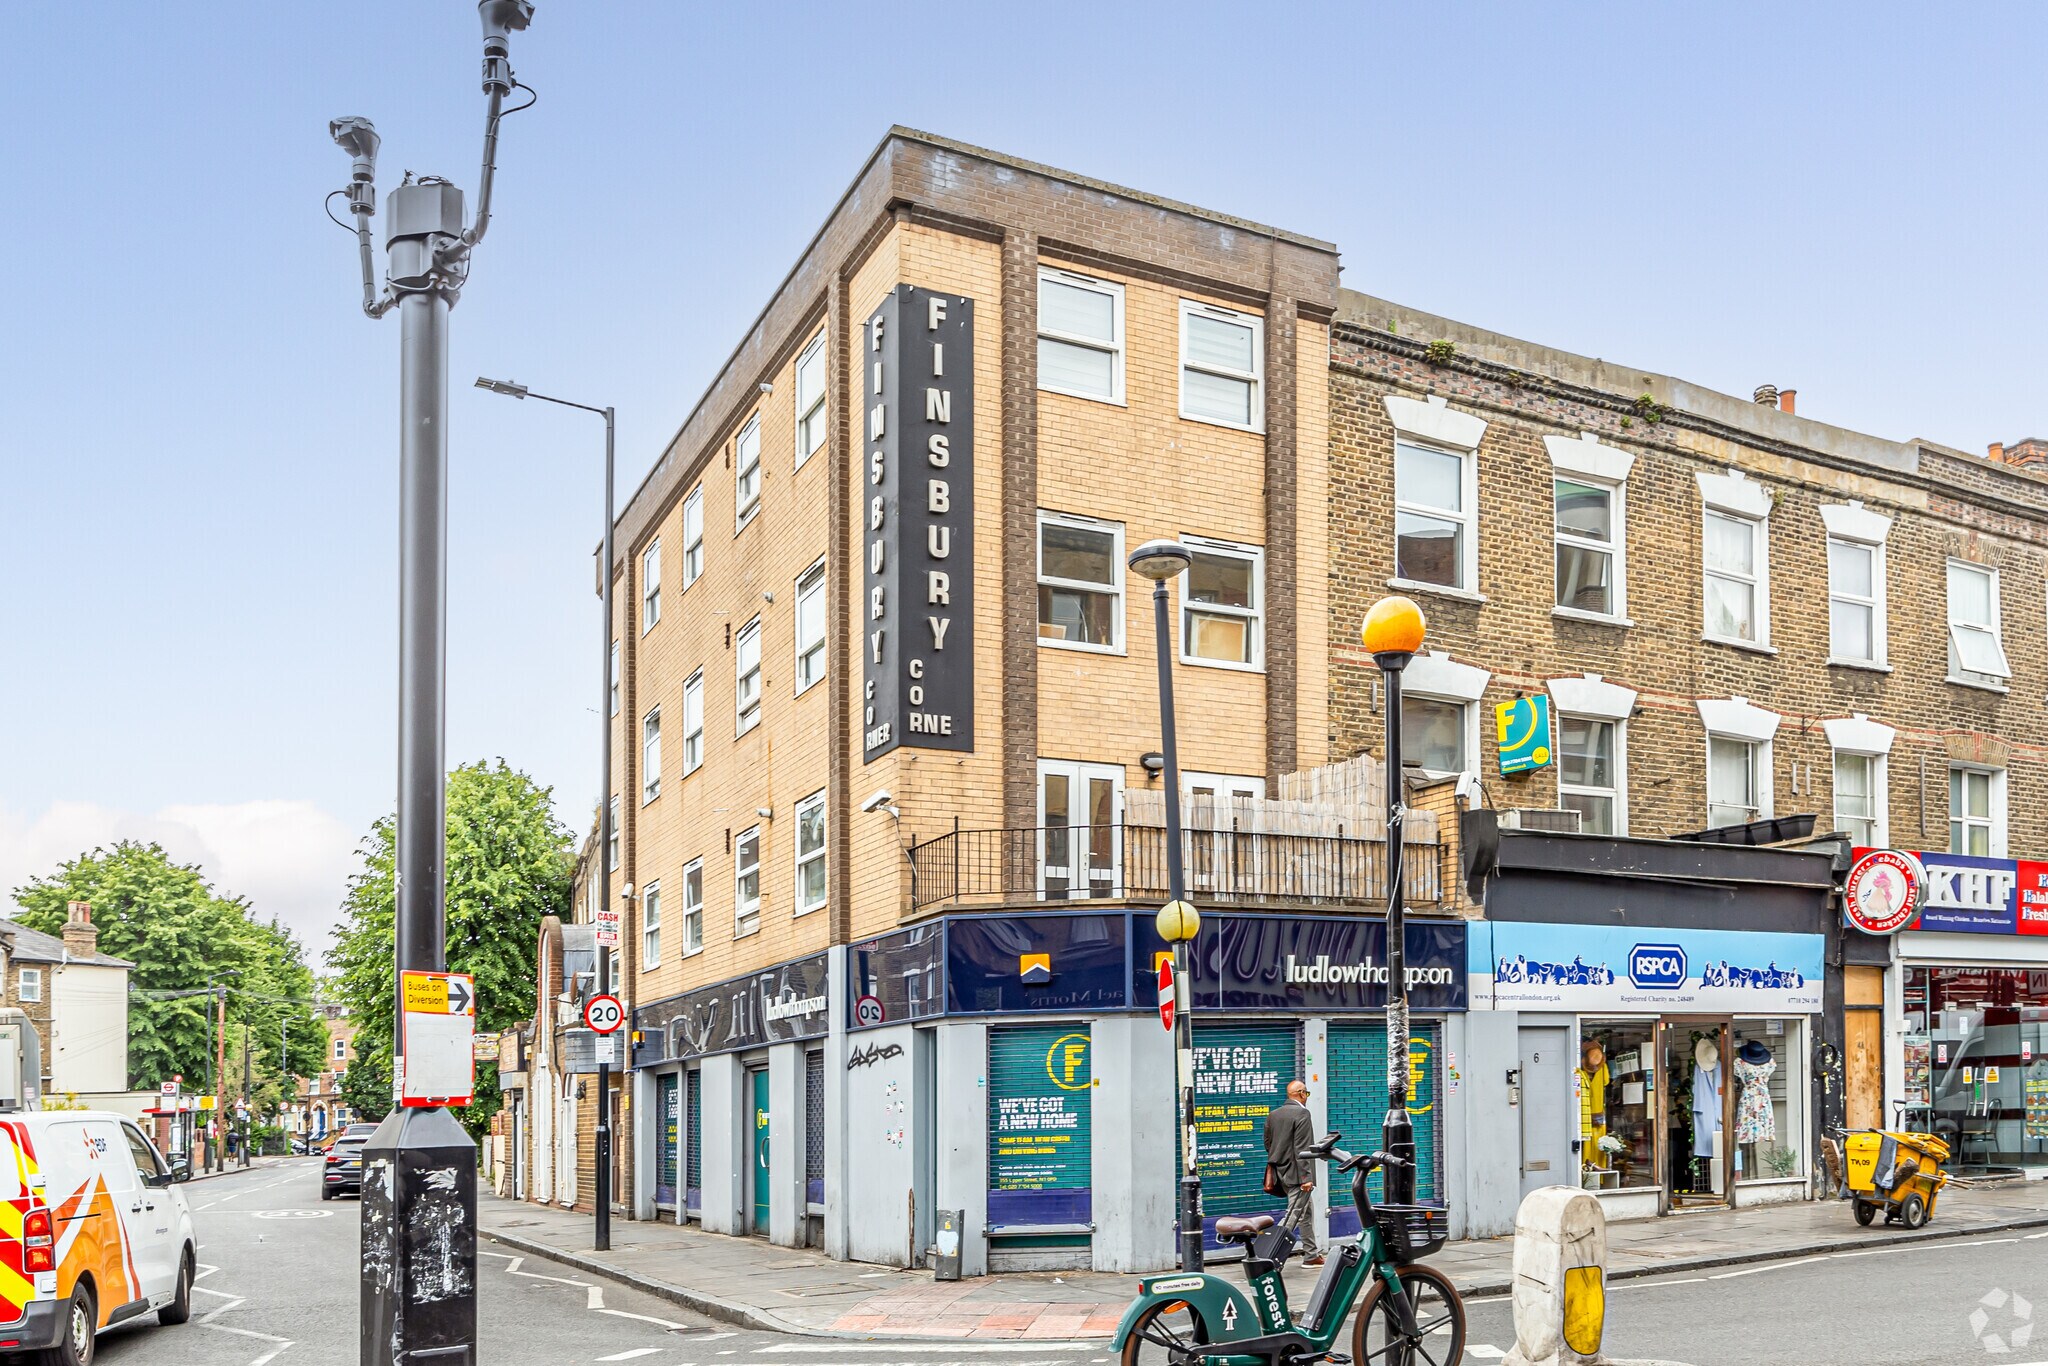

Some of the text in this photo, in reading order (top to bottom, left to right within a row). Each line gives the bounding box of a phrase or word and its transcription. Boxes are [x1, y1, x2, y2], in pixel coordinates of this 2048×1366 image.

[926, 297, 951, 650] FINSBURY
[871, 315, 884, 664] FINSBURY
[1873, 855, 1906, 870] Kebabs
[1924, 864, 2016, 912] KHF
[597, 912, 619, 922] CASH
[1877, 908, 1908, 928] chicken
[1636, 956, 1681, 976] RSPCA
[408, 981, 430, 991] Buses
[408, 994, 444, 1005] Diversion
[1620, 995, 1647, 1003] Registered
[1648, 995, 1667, 1003] Charity
[592, 1007, 619, 1022] 20
[1232, 1047, 1261, 1069] GOT
[1533, 1052, 1540, 1063] 6
[1616, 1053, 1637, 1063] CLOSED
[1196, 1071, 1278, 1093] NEW HOME
[999, 1096, 1065, 1114] WE'VE GOT
[998, 1112, 1078, 1130] A NEW HOME
[1261, 1276, 1286, 1329] forest
